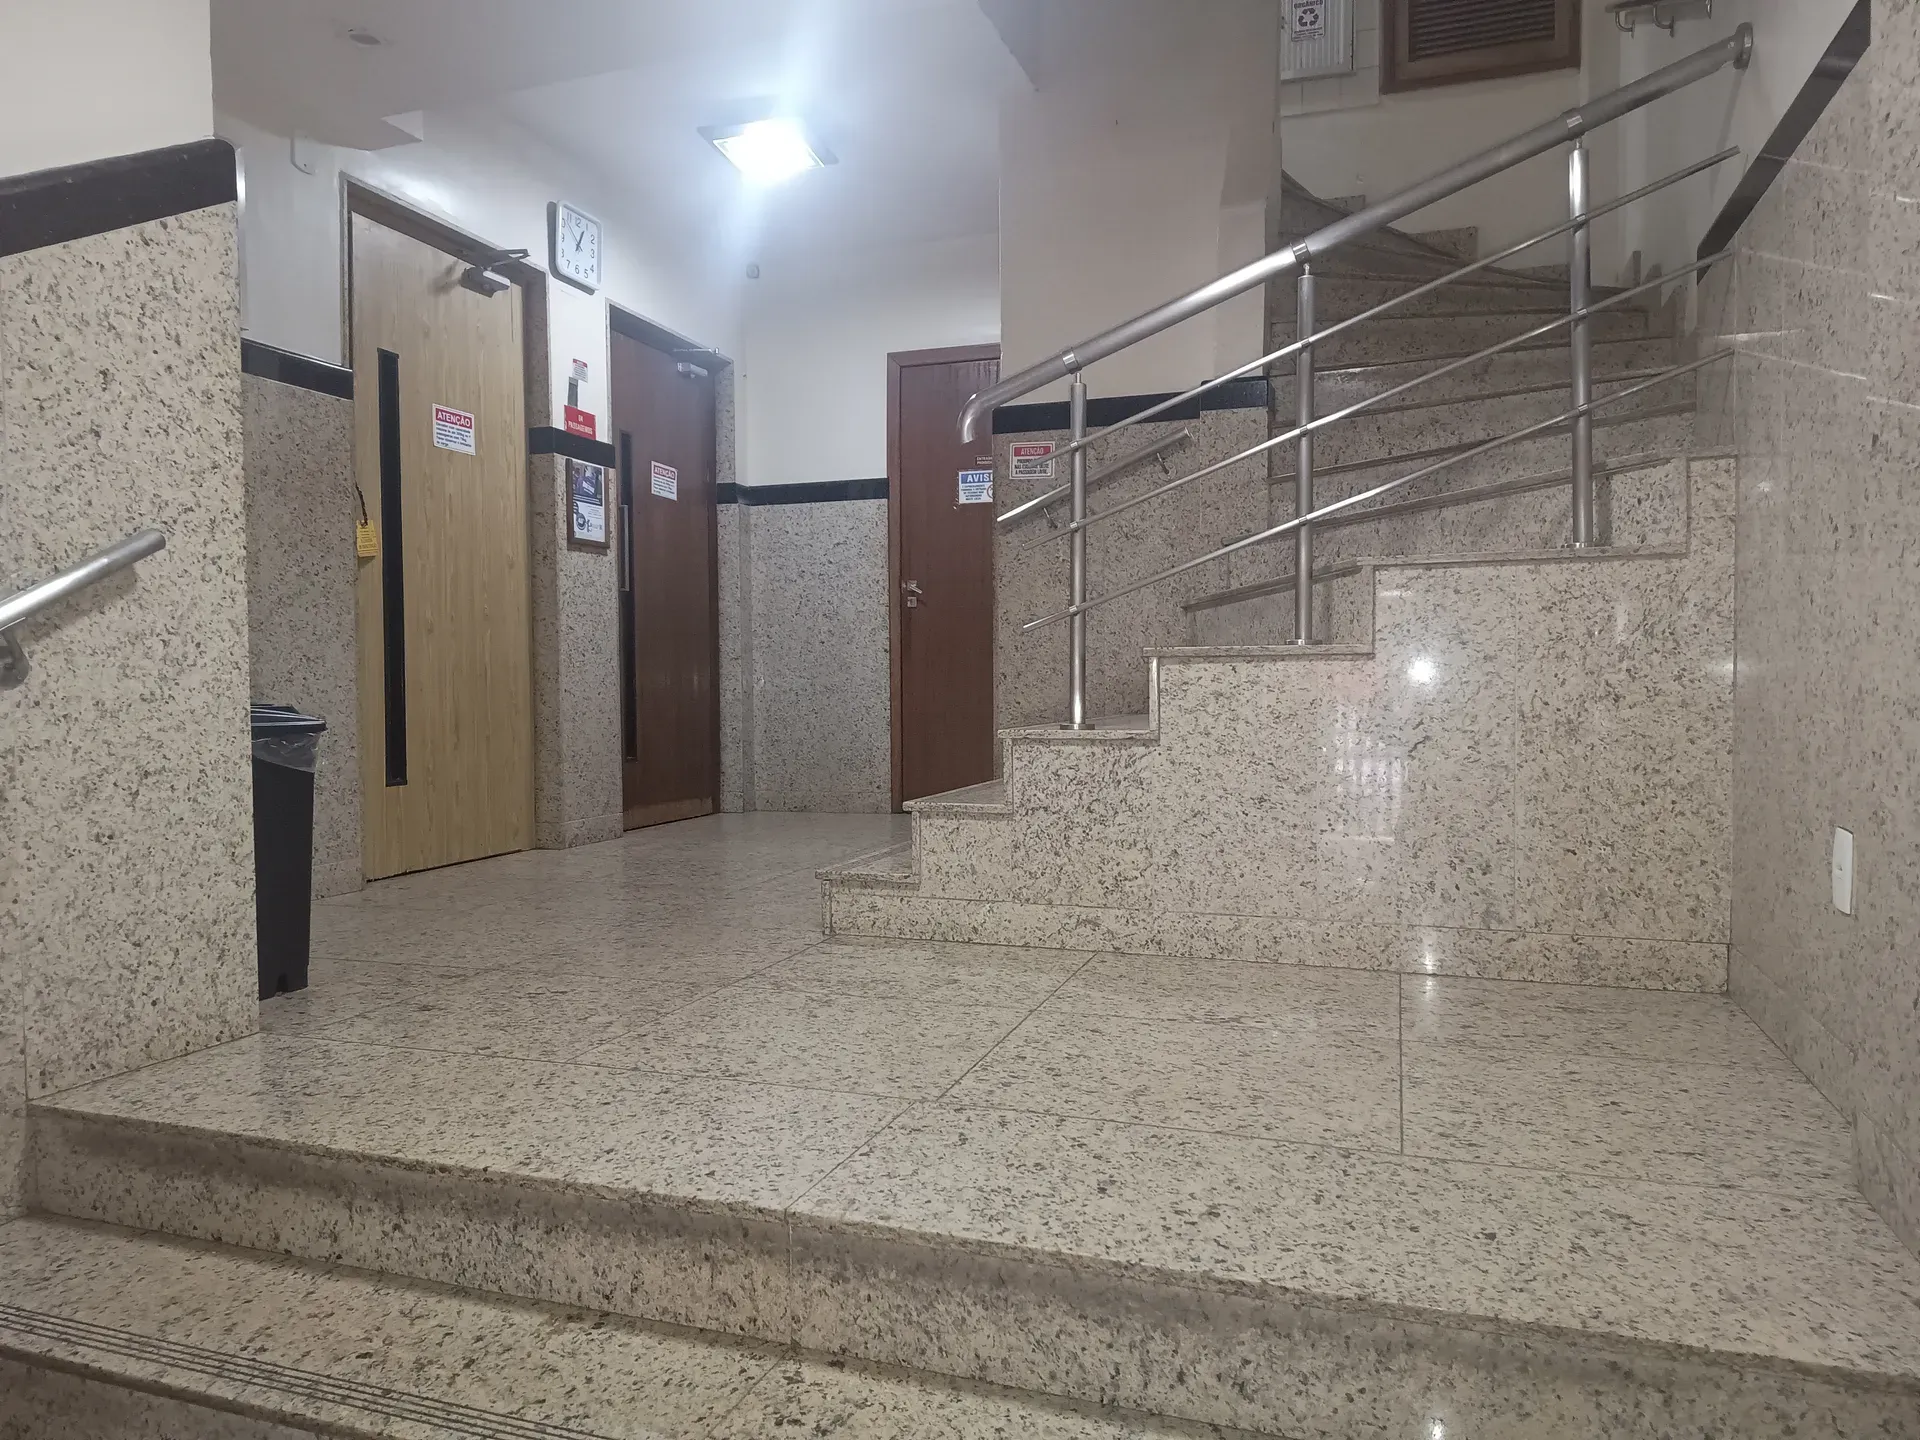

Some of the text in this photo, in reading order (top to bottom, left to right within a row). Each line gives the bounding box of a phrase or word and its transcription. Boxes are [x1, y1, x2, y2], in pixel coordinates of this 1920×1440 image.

[590, 233, 596, 245] 2
[590, 248, 595, 259] 3
[566, 259, 571, 269] 7
[574, 264, 580, 275] 6
[590, 264, 595, 274] 4
[584, 268, 589, 279] 5
[437, 410, 471, 428] ATENÇÃO
[568, 420, 593, 435] PASSAGEIROS
[1020, 446, 1044, 456] ATENÇÃO
[654, 466, 675, 479] ATENÇÃO
